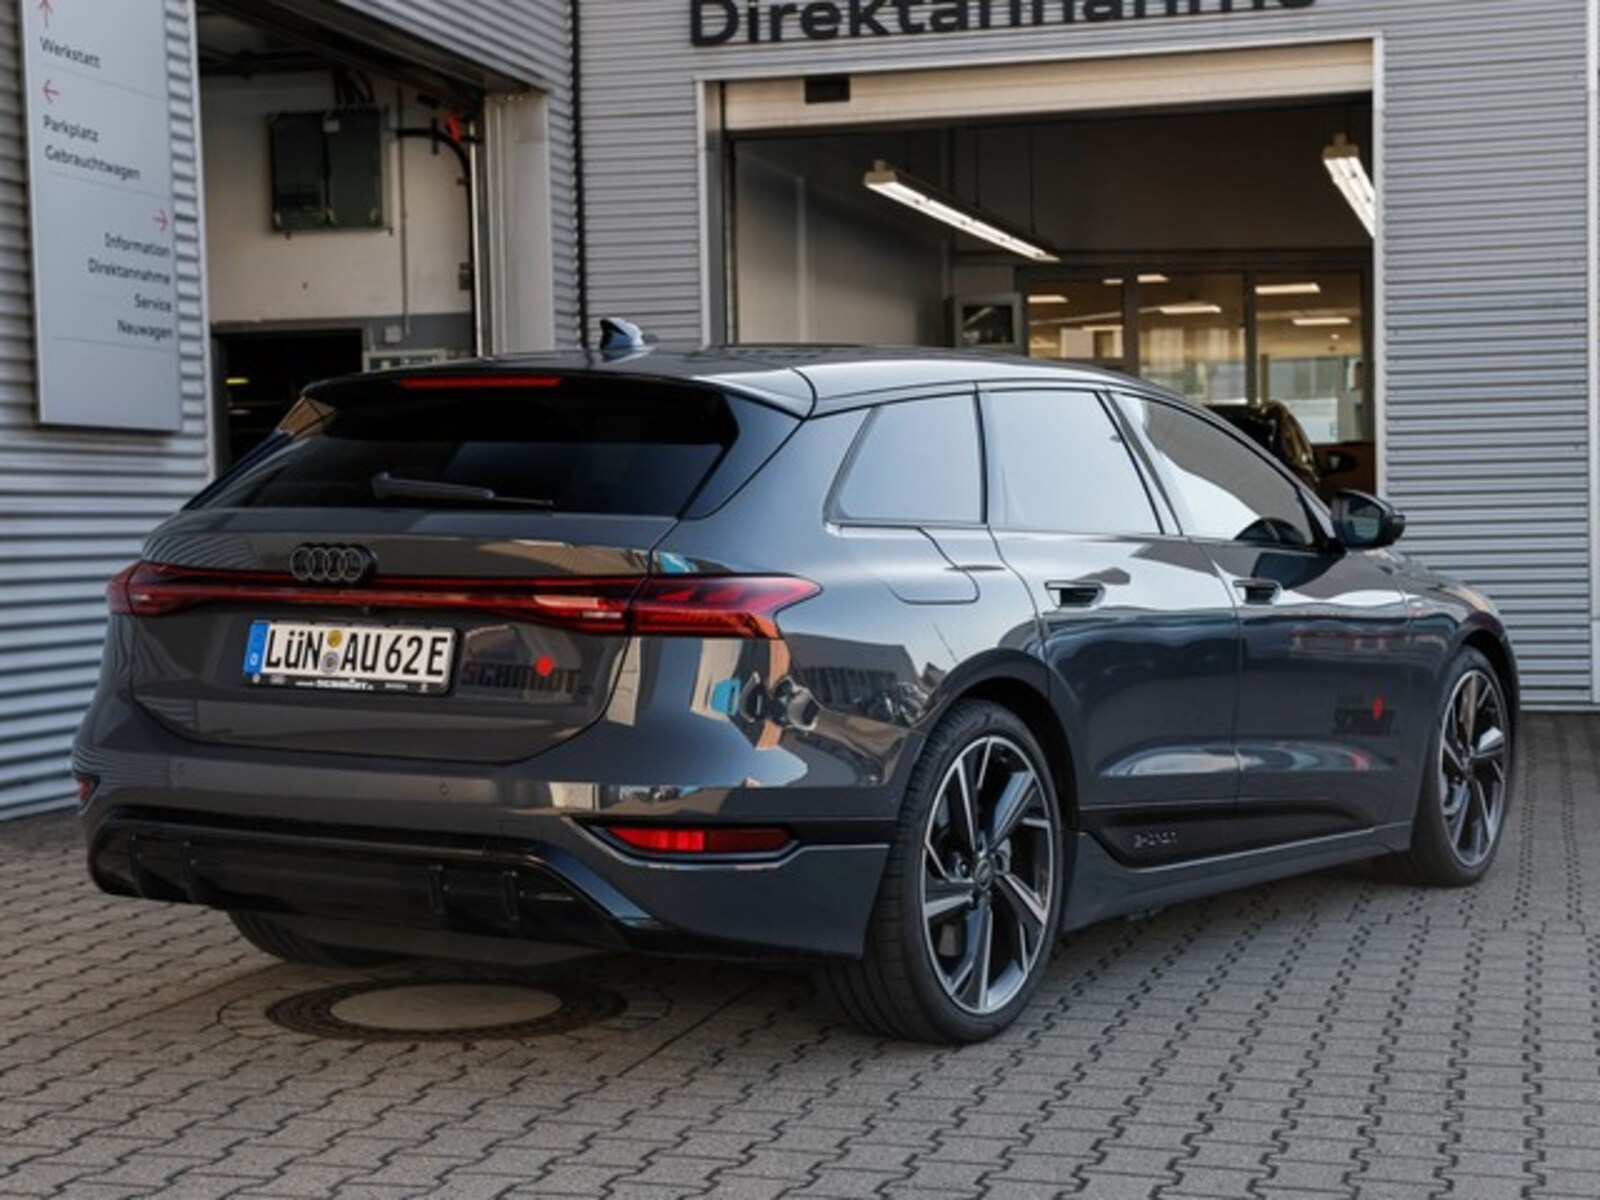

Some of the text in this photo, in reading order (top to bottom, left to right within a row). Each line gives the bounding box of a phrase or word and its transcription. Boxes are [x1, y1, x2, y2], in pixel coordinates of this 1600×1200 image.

[689, 0, 1315, 47] Direktanna
[40, 37, 101, 68] Werkstatt
[43, 114, 99, 142] Parkplatz
[45, 144, 141, 181] Gebrauchtwagen
[104, 232, 170, 257] Information
[87, 257, 171, 284] Direktannahme
[134, 293, 172, 312] Service
[117, 319, 173, 341] Neuwagen
